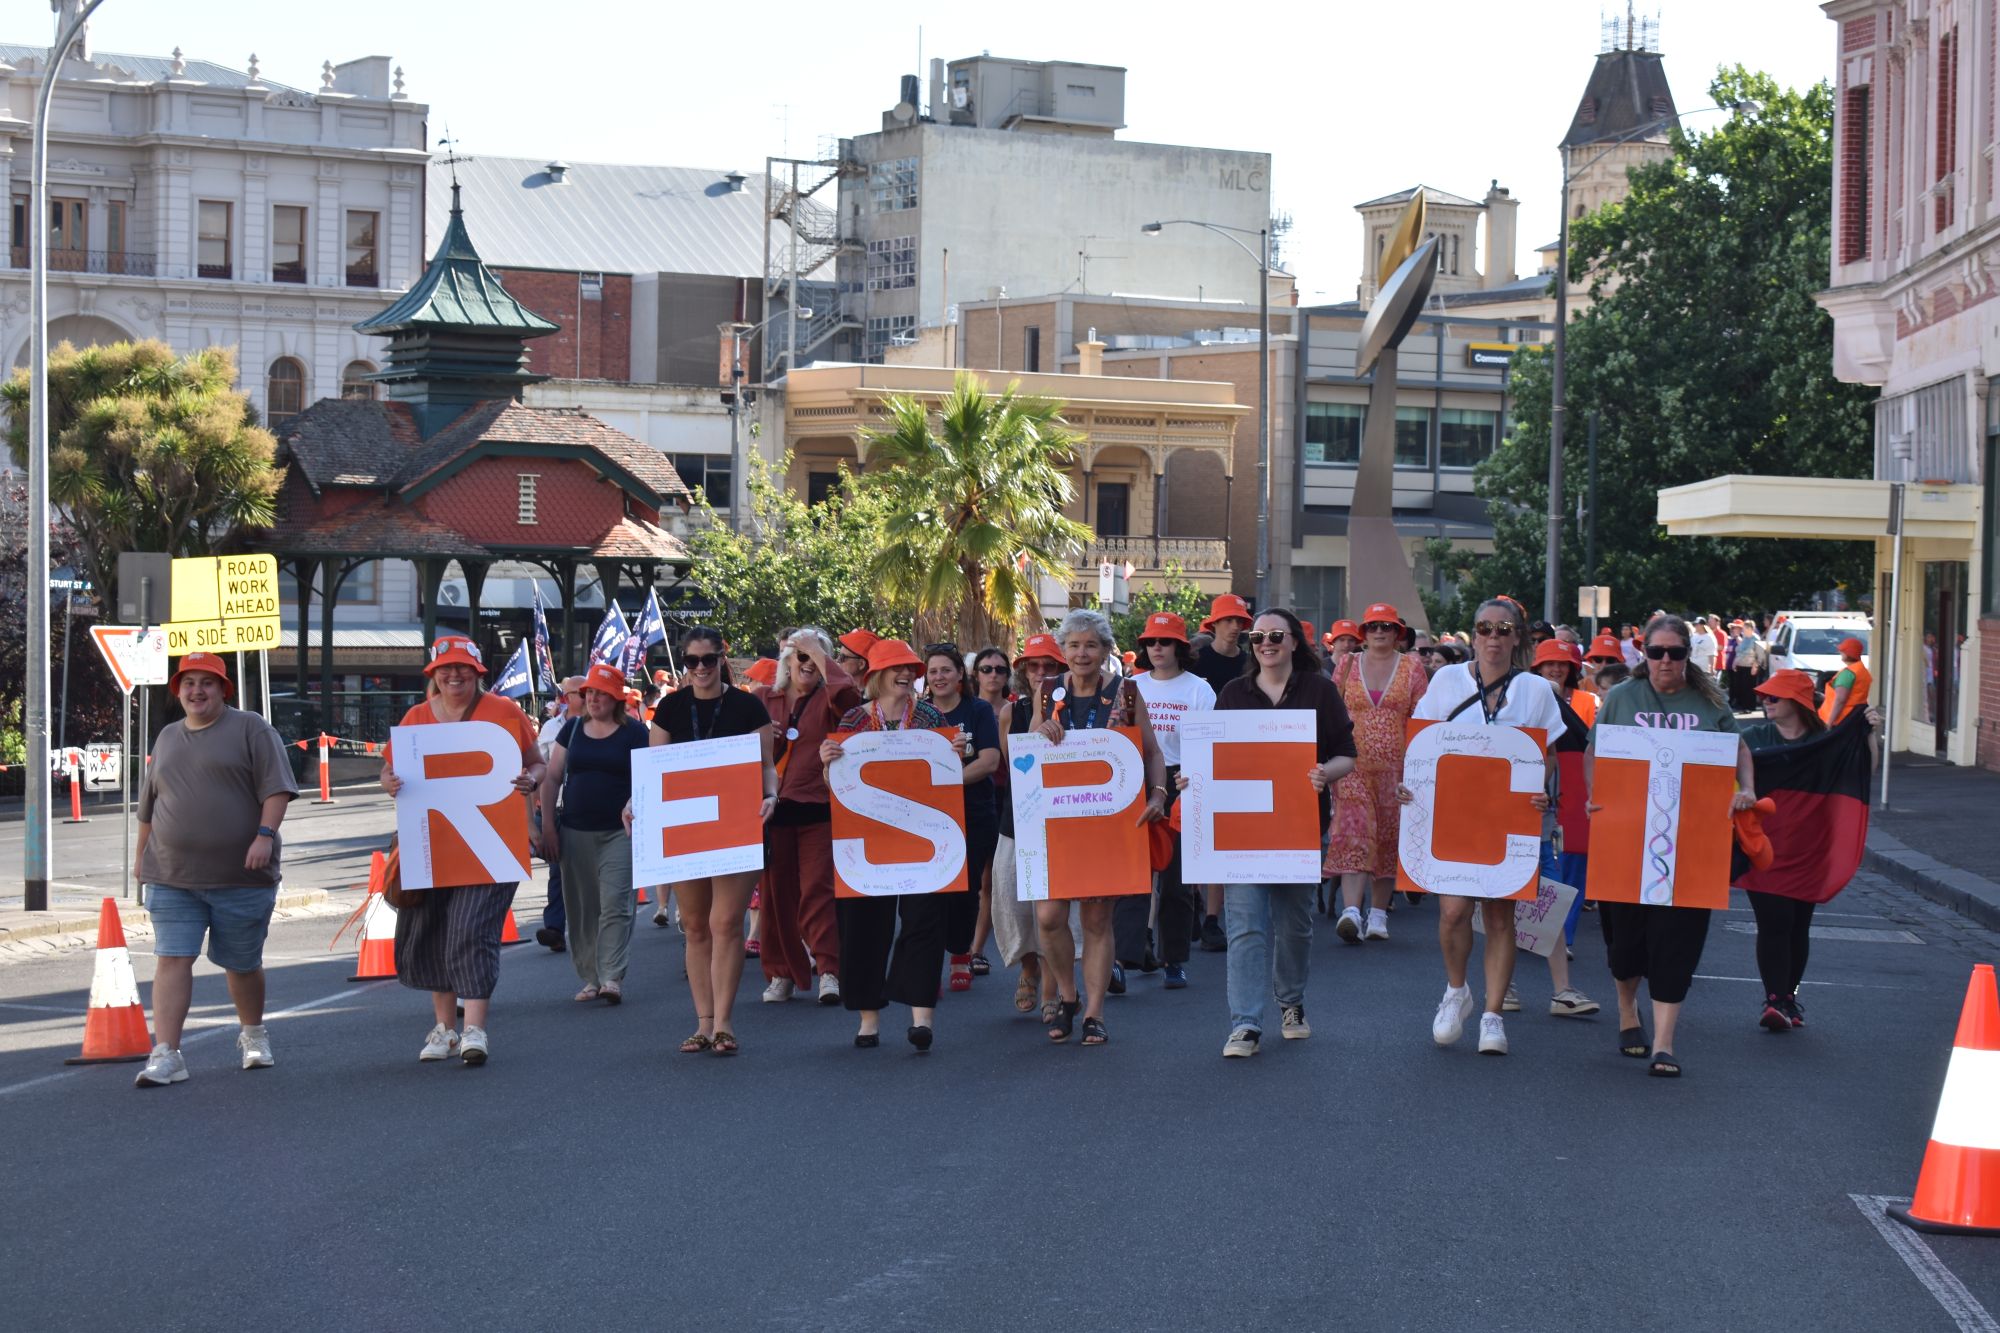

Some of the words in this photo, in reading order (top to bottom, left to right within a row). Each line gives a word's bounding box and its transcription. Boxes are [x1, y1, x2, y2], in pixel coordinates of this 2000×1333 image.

[1219, 168, 1263, 192] MLC
[227, 560, 268, 575] ROAD
[49, 579, 72, 588] STURT
[73, 581, 84, 589] ST
[227, 579, 269, 594] WORK
[225, 598, 274, 614] AHEAD
[661, 609, 712, 618] omeground
[168, 631, 188, 649] ON
[196, 628, 228, 645] SIDE
[236, 625, 274, 643] ROAD
[1162, 703, 1188, 711] POWER
[1634, 711, 1700, 730] STOP
[91, 747, 116, 758] ONE
[89, 762, 117, 773] WAY
[390, 721, 532, 890] R
[1053, 791, 1113, 805] NETWORKING
[1180, 709, 1322, 884] E
[631, 733, 764, 889] E
[829, 729, 966, 897] S
[1007, 728, 1146, 901] P
[1398, 721, 1546, 898] C
[1593, 724, 1740, 907] T
